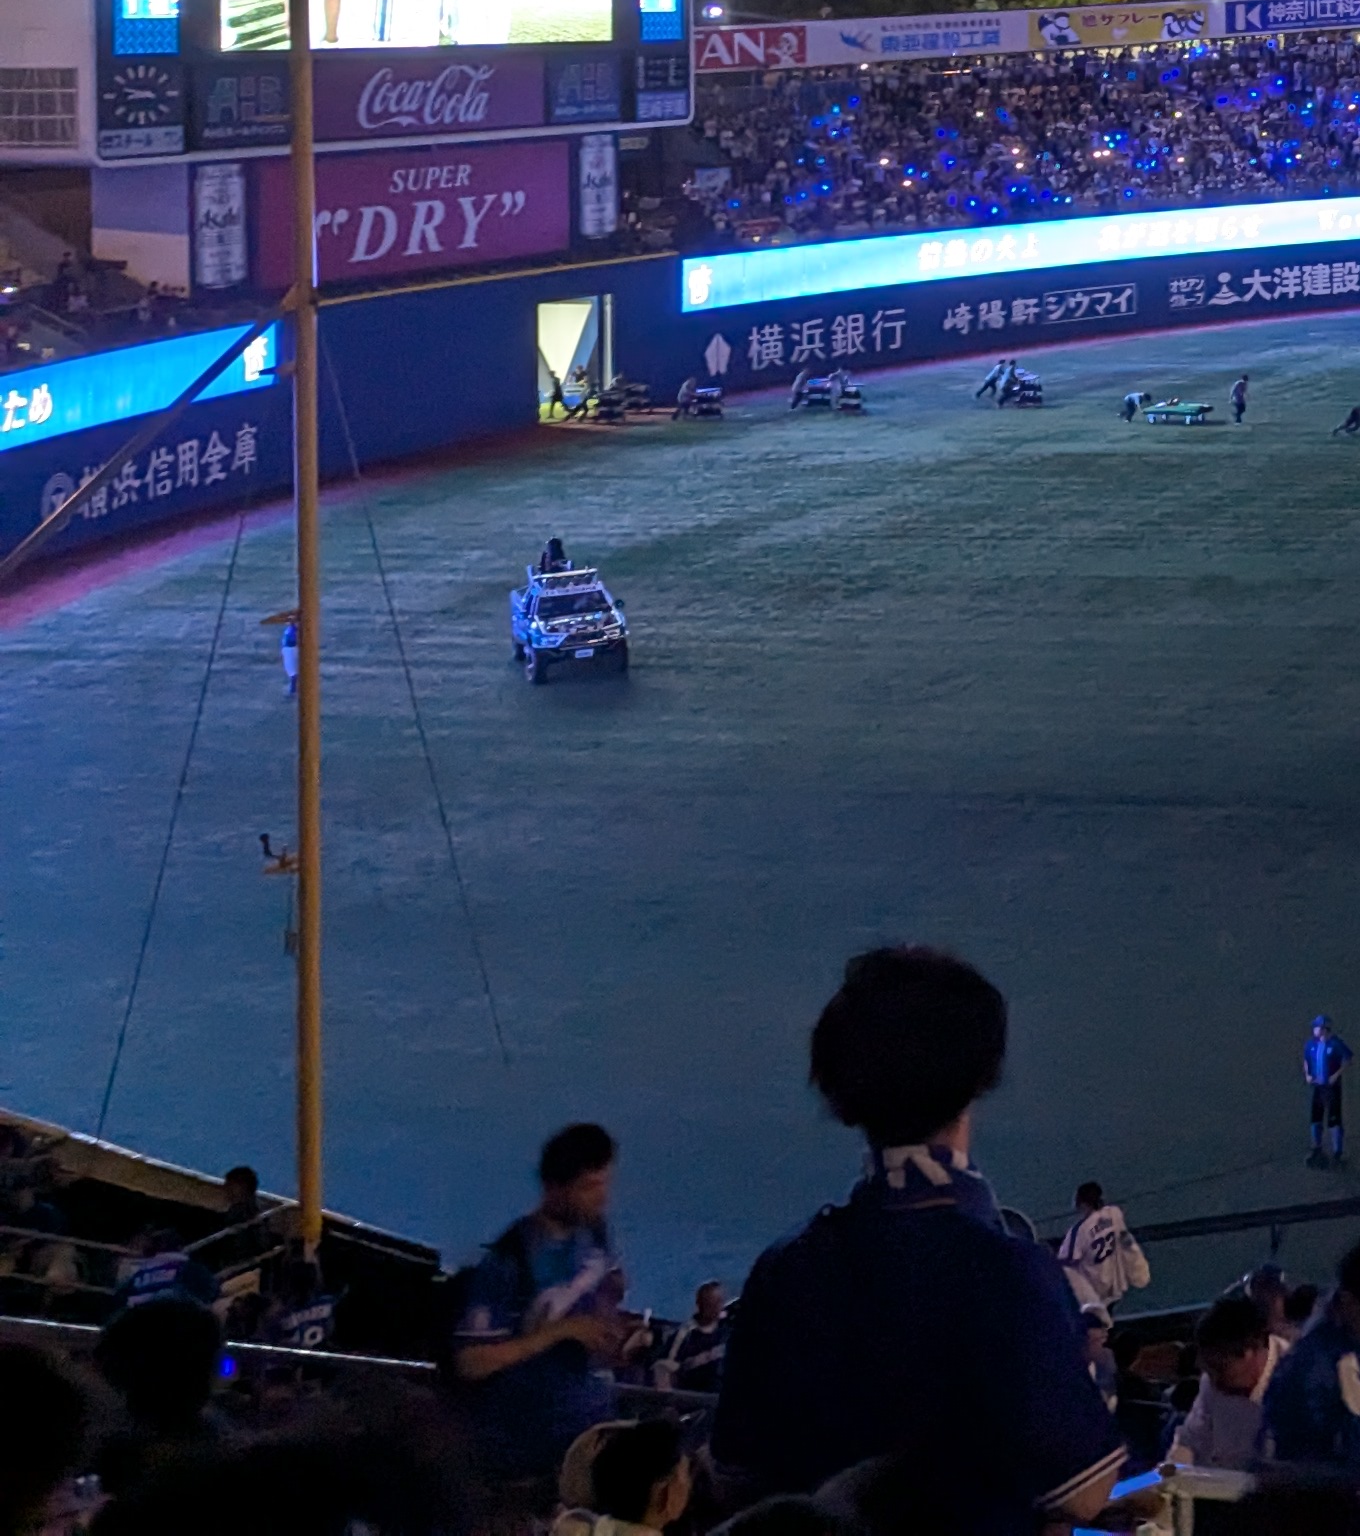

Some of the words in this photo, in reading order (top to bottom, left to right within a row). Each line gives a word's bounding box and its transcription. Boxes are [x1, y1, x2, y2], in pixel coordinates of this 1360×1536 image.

[357, 63, 496, 129] Coca-Cola
[388, 164, 473, 194] SUPER
[1241, 260, 1360, 303] 大洋建設
[943, 295, 1041, 336] 崎陽軒
[1046, 286, 1134, 321] シウマイ
[747, 306, 907, 371] 横浜銀行
